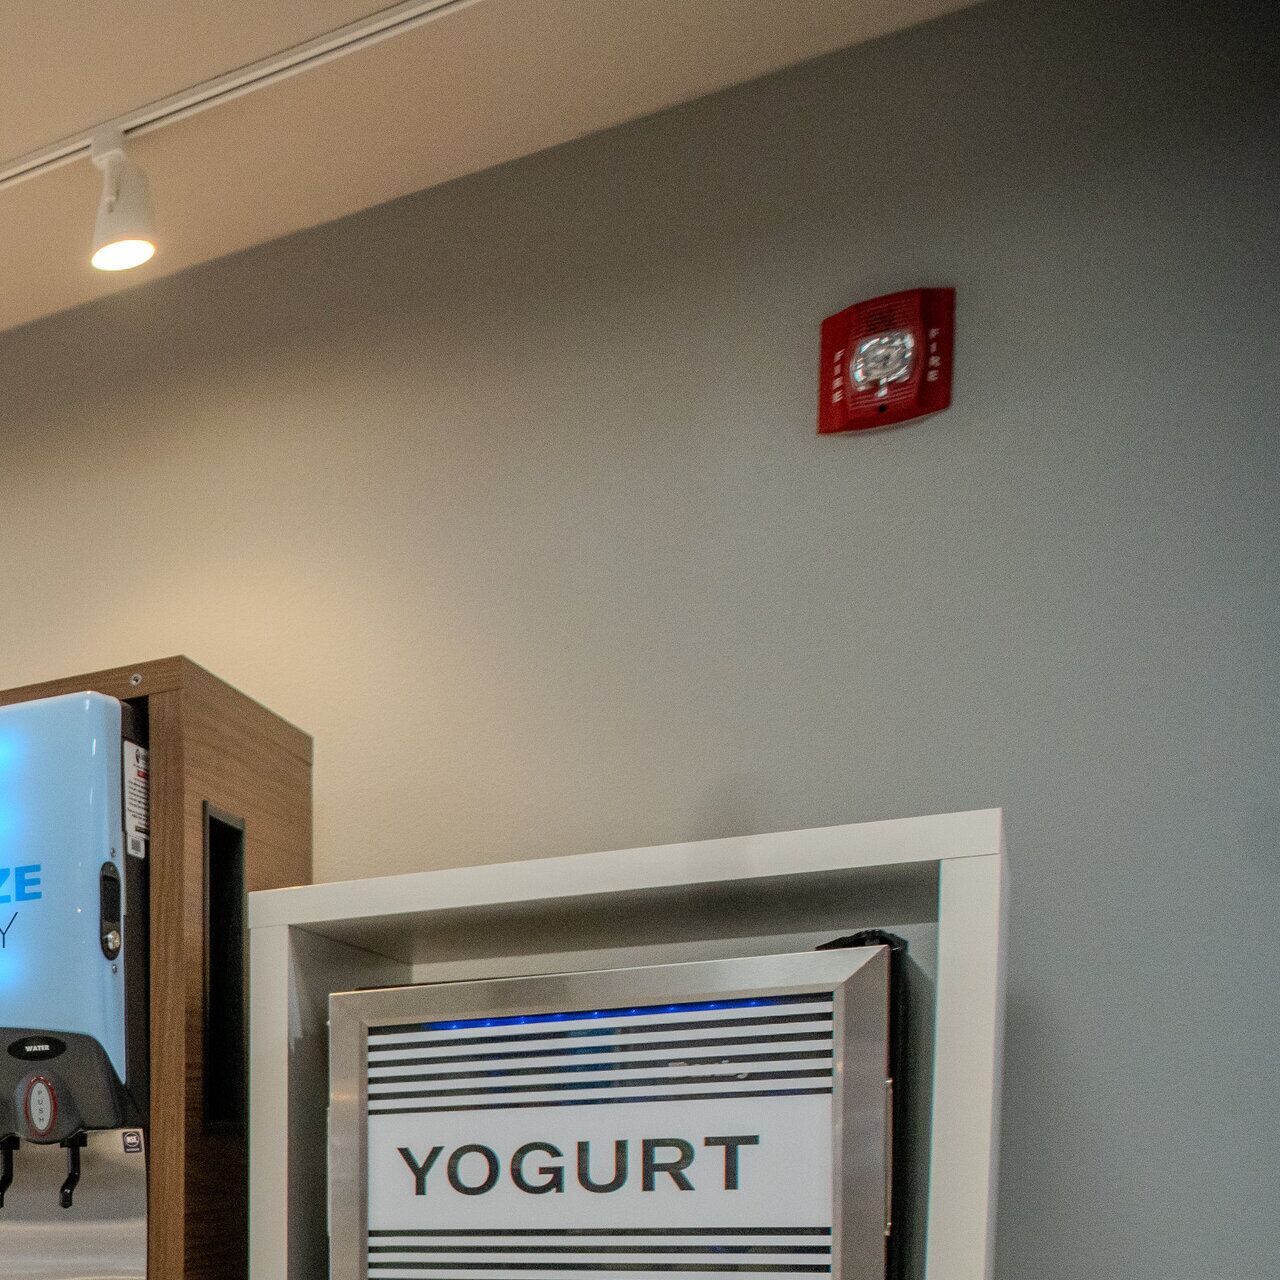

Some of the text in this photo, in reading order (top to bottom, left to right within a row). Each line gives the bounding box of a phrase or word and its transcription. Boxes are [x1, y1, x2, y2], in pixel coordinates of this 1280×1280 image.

[832, 349, 845, 404] FIRE
[927, 328, 941, 382] FIRE
[24, 1044, 50, 1052] WATER
[397, 1135, 761, 1196] YOGURT
